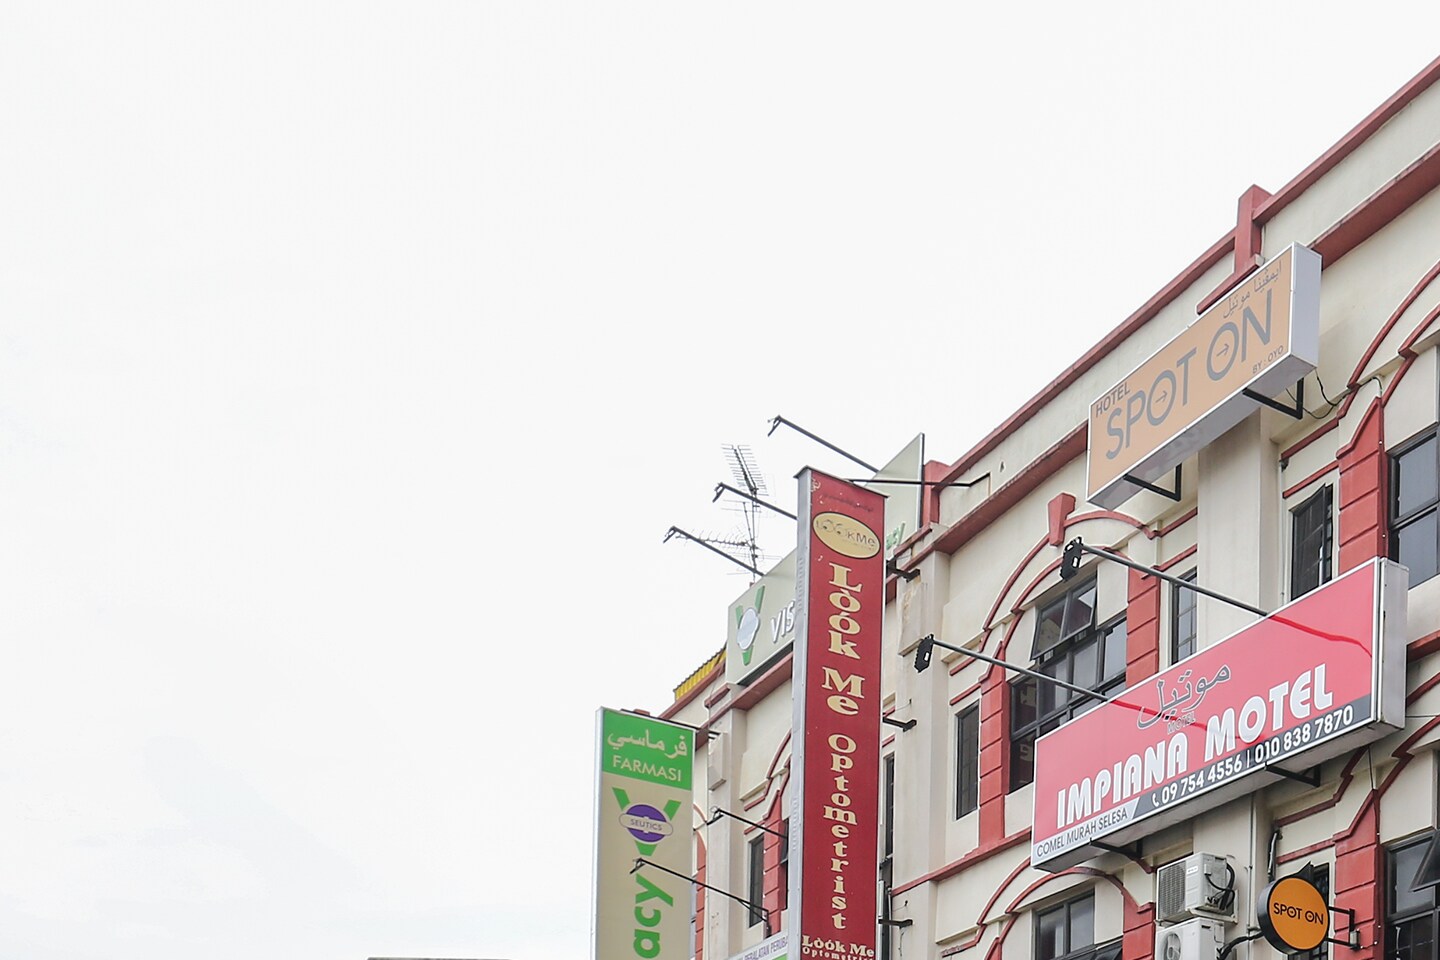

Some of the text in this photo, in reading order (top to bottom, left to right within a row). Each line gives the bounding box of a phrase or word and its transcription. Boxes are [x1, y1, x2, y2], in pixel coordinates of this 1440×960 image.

[1105, 288, 1272, 460] SPOT ON
[1252, 345, 1284, 374] BY OYO
[1095, 381, 1131, 418] HOTEL
[822, 667, 865, 717] Me
[1167, 713, 1196, 735] MOTEL
[607, 729, 687, 759] فرماسي
[1056, 662, 1333, 830] IMPIANA MOTEL
[1162, 704, 1353, 804] 09 754 4556 010 838 7870
[612, 755, 682, 781] FARMASI
[630, 818, 662, 831] SEUTICS
[822, 732, 859, 930] Optometrist
[1036, 807, 1128, 858] COMEL MURAH SELESA
[1273, 902, 1324, 925] SPOT ON
[849, 944, 875, 958] Me
